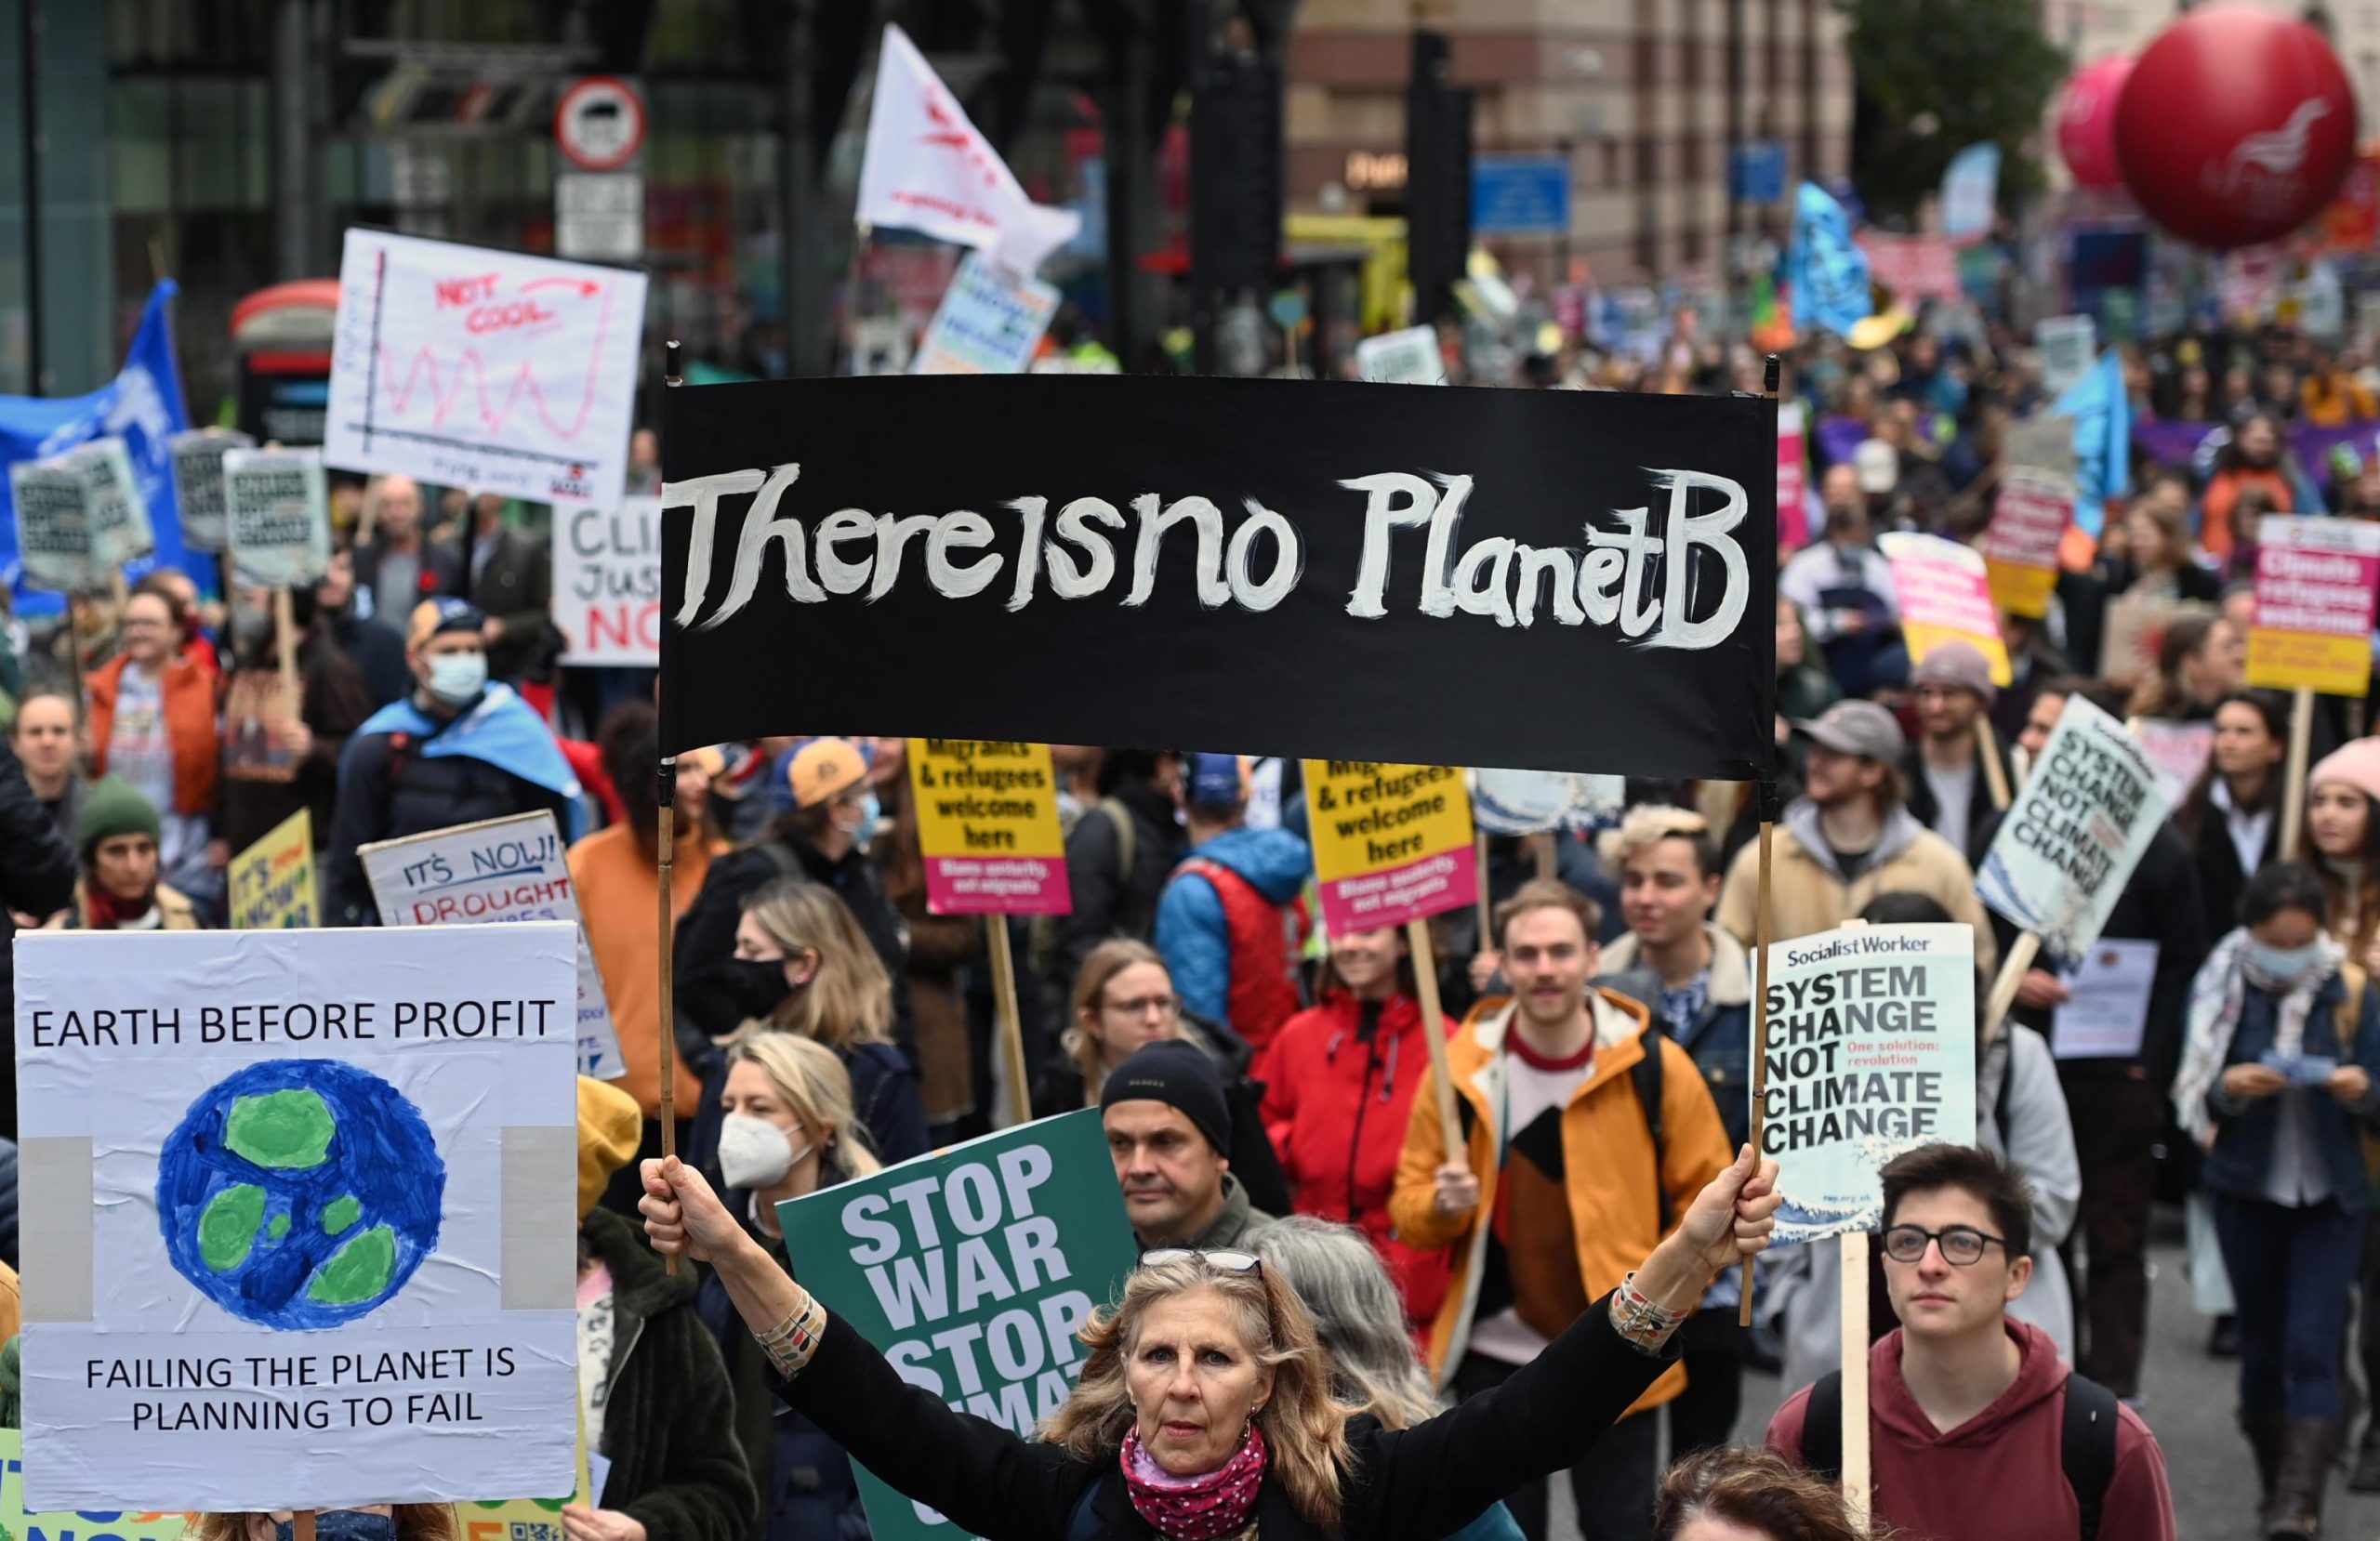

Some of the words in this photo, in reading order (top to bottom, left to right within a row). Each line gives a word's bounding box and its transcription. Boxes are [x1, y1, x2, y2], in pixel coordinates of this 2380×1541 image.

[434, 272, 500, 309] NOT
[467, 301, 554, 334] COOL
[570, 510, 661, 557] CLI
[662, 463, 1004, 630] There
[1119, 493, 1304, 612] no
[1335, 468, 1664, 638] Planet
[1638, 467, 1750, 650] B
[588, 599, 659, 650] NO
[943, 766, 1045, 793] refugees
[1318, 787, 1336, 811] &
[1346, 766, 1454, 806] refugees
[2063, 729, 2147, 808] SYSTEM
[936, 794, 1037, 818] welcome
[1335, 795, 1446, 837] welcome
[2039, 775, 2091, 819] NOT
[2051, 754, 2137, 837] CHANGE
[964, 822, 1015, 849] here
[1367, 834, 1424, 864] here
[2027, 798, 2115, 879] CLIMATE
[403, 852, 454, 887] IT'S
[470, 835, 554, 875] NOW!
[2014, 822, 2098, 897] CHANGE
[413, 878, 569, 926] DROUGHT
[1788, 939, 1859, 968] Socialist
[1861, 935, 1931, 955] Worker
[1765, 966, 1926, 1016] SYSTEM
[33, 1008, 181, 1047] EARTH
[200, 1002, 376, 1043] BEFORE
[393, 999, 556, 1038] PROFIT
[1765, 1001, 1937, 1049] CHANGE
[1847, 1041, 1874, 1053] One
[1878, 1040, 1939, 1052] solution:
[1765, 1042, 1840, 1085] NOT
[1847, 1054, 1918, 1067] revolution
[1764, 1072, 1942, 1119] CLIMATE
[1762, 1107, 1937, 1155] CHANGE
[841, 1144, 1052, 1266] STOP
[864, 1216, 1073, 1331] WAR
[86, 1357, 232, 1390] FAILING
[245, 1356, 318, 1387] THE
[332, 1349, 473, 1384] PLANET
[486, 1347, 516, 1376] IS
[884, 1290, 1093, 1401] STOP
[133, 1400, 330, 1431] PLANNING
[341, 1397, 394, 1427] TO
[407, 1392, 483, 1424] FAIL
